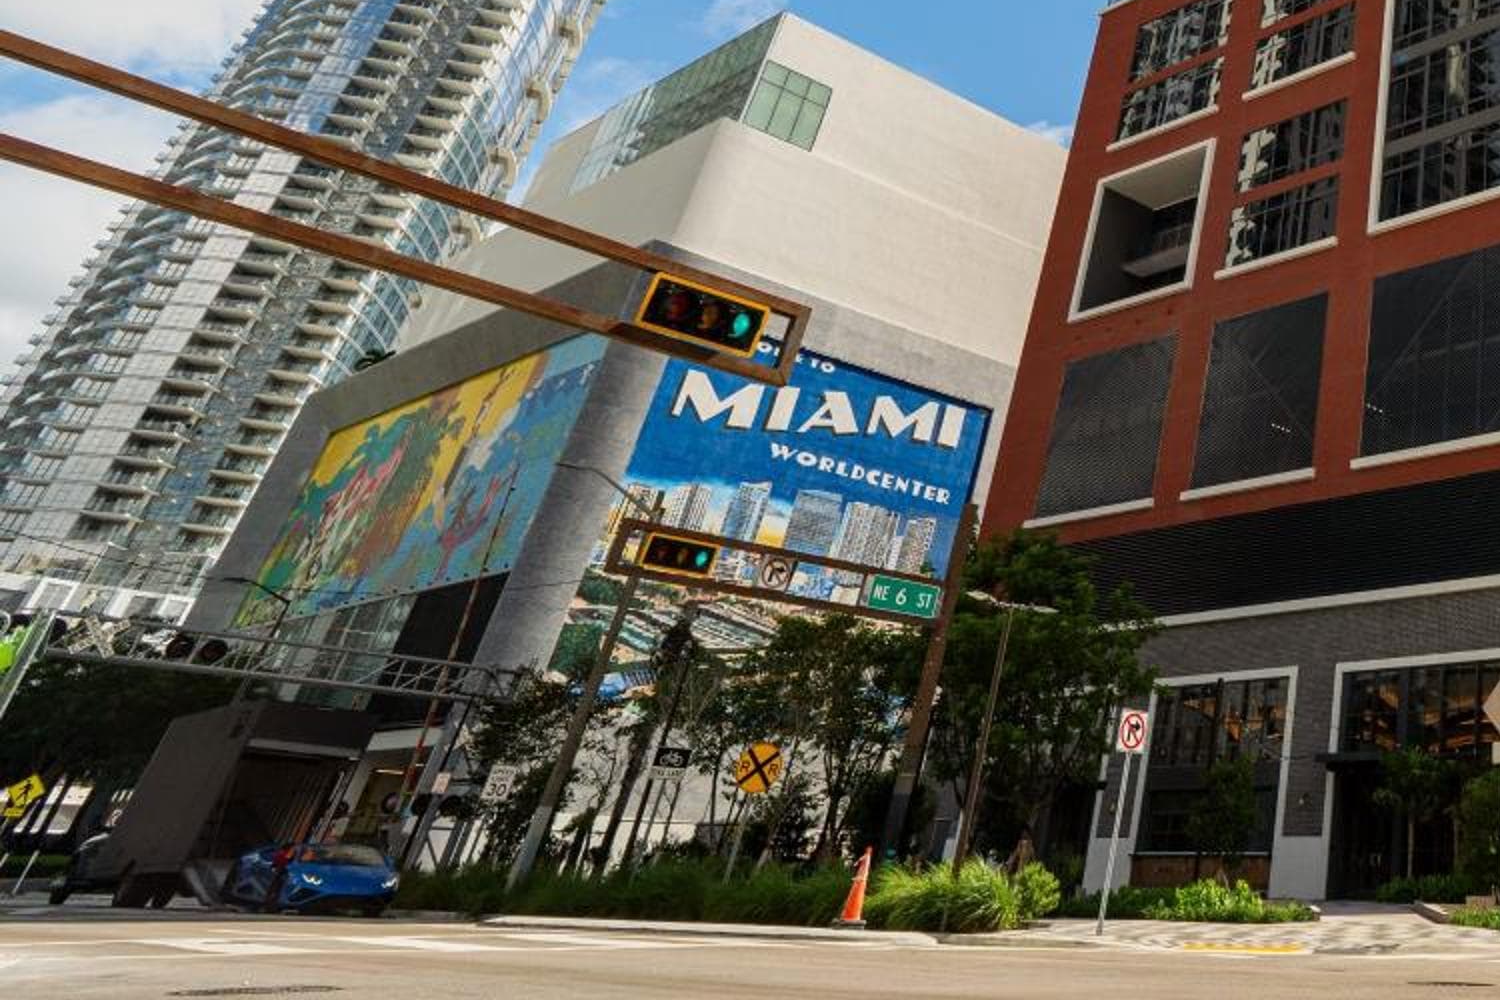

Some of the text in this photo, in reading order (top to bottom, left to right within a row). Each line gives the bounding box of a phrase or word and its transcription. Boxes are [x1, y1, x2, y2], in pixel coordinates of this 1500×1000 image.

[810, 358, 836, 374] TO
[671, 368, 968, 449] MIAMI
[770, 441, 950, 505] WORLDCENTER
[871, 583, 933, 609] NE 6 ST
[740, 760, 779, 777] R R
[486, 783, 507, 797] 30
